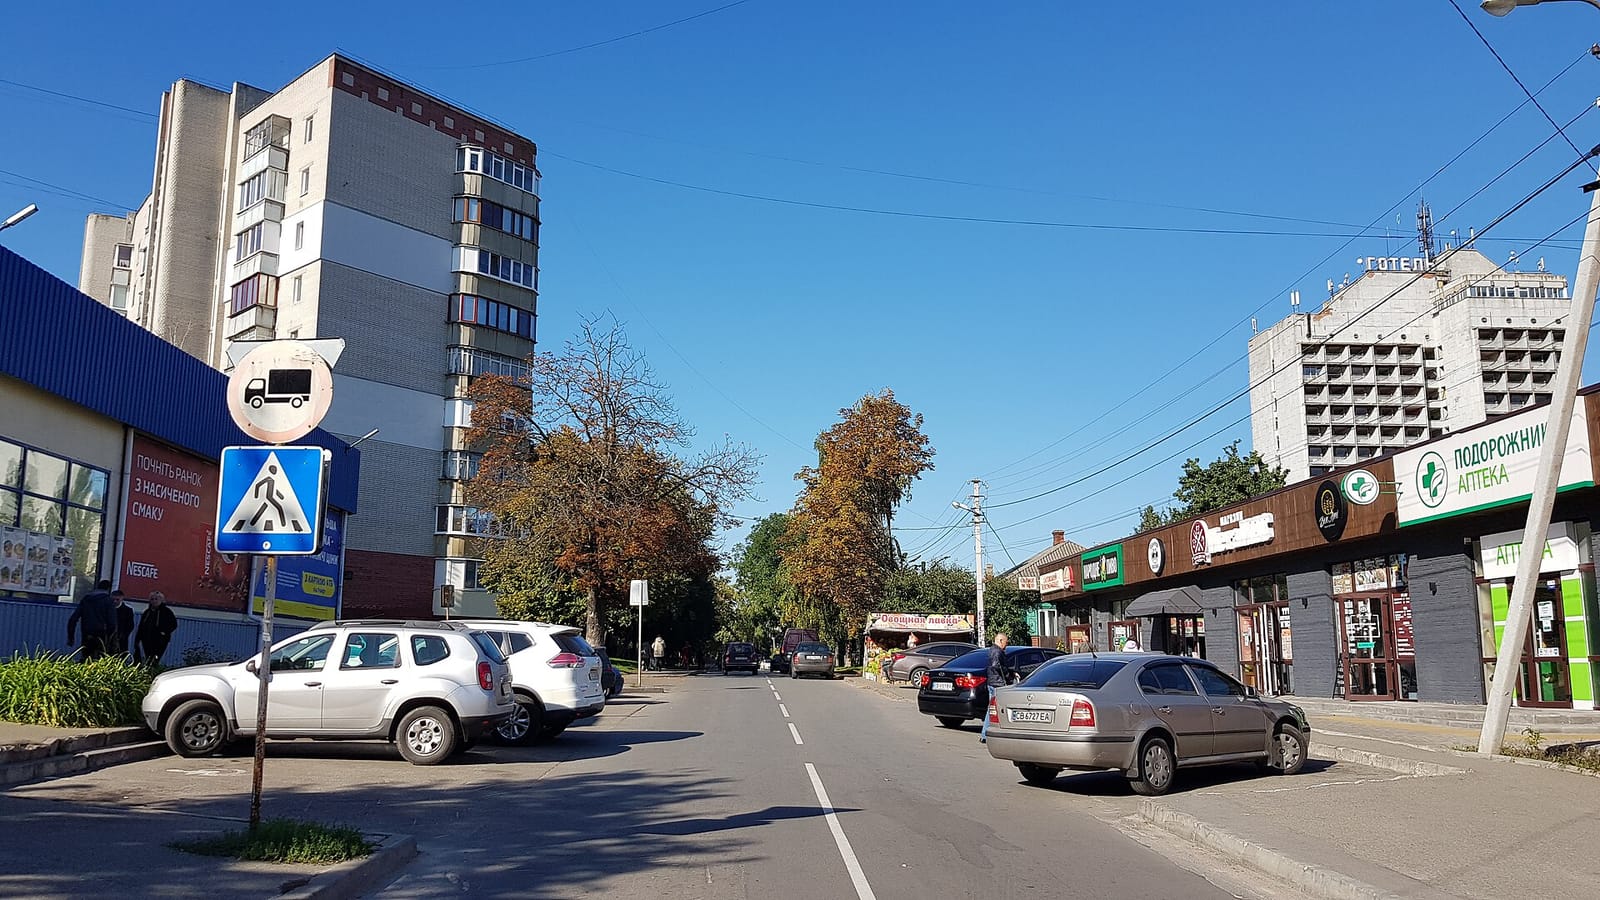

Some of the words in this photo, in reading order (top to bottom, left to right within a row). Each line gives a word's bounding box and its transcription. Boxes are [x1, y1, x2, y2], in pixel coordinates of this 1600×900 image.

[1367, 256, 1435, 271] ГОТЕЛЬ
[136, 454, 175, 479] ПОЧНІТЬ
[175, 467, 203, 487] РАНОК
[1458, 463, 1509, 494] АПТЕКА
[135, 477, 142, 492] З
[142, 480, 200, 508] НАСИЧЕНОГО
[132, 501, 164, 521] СМАКУ
